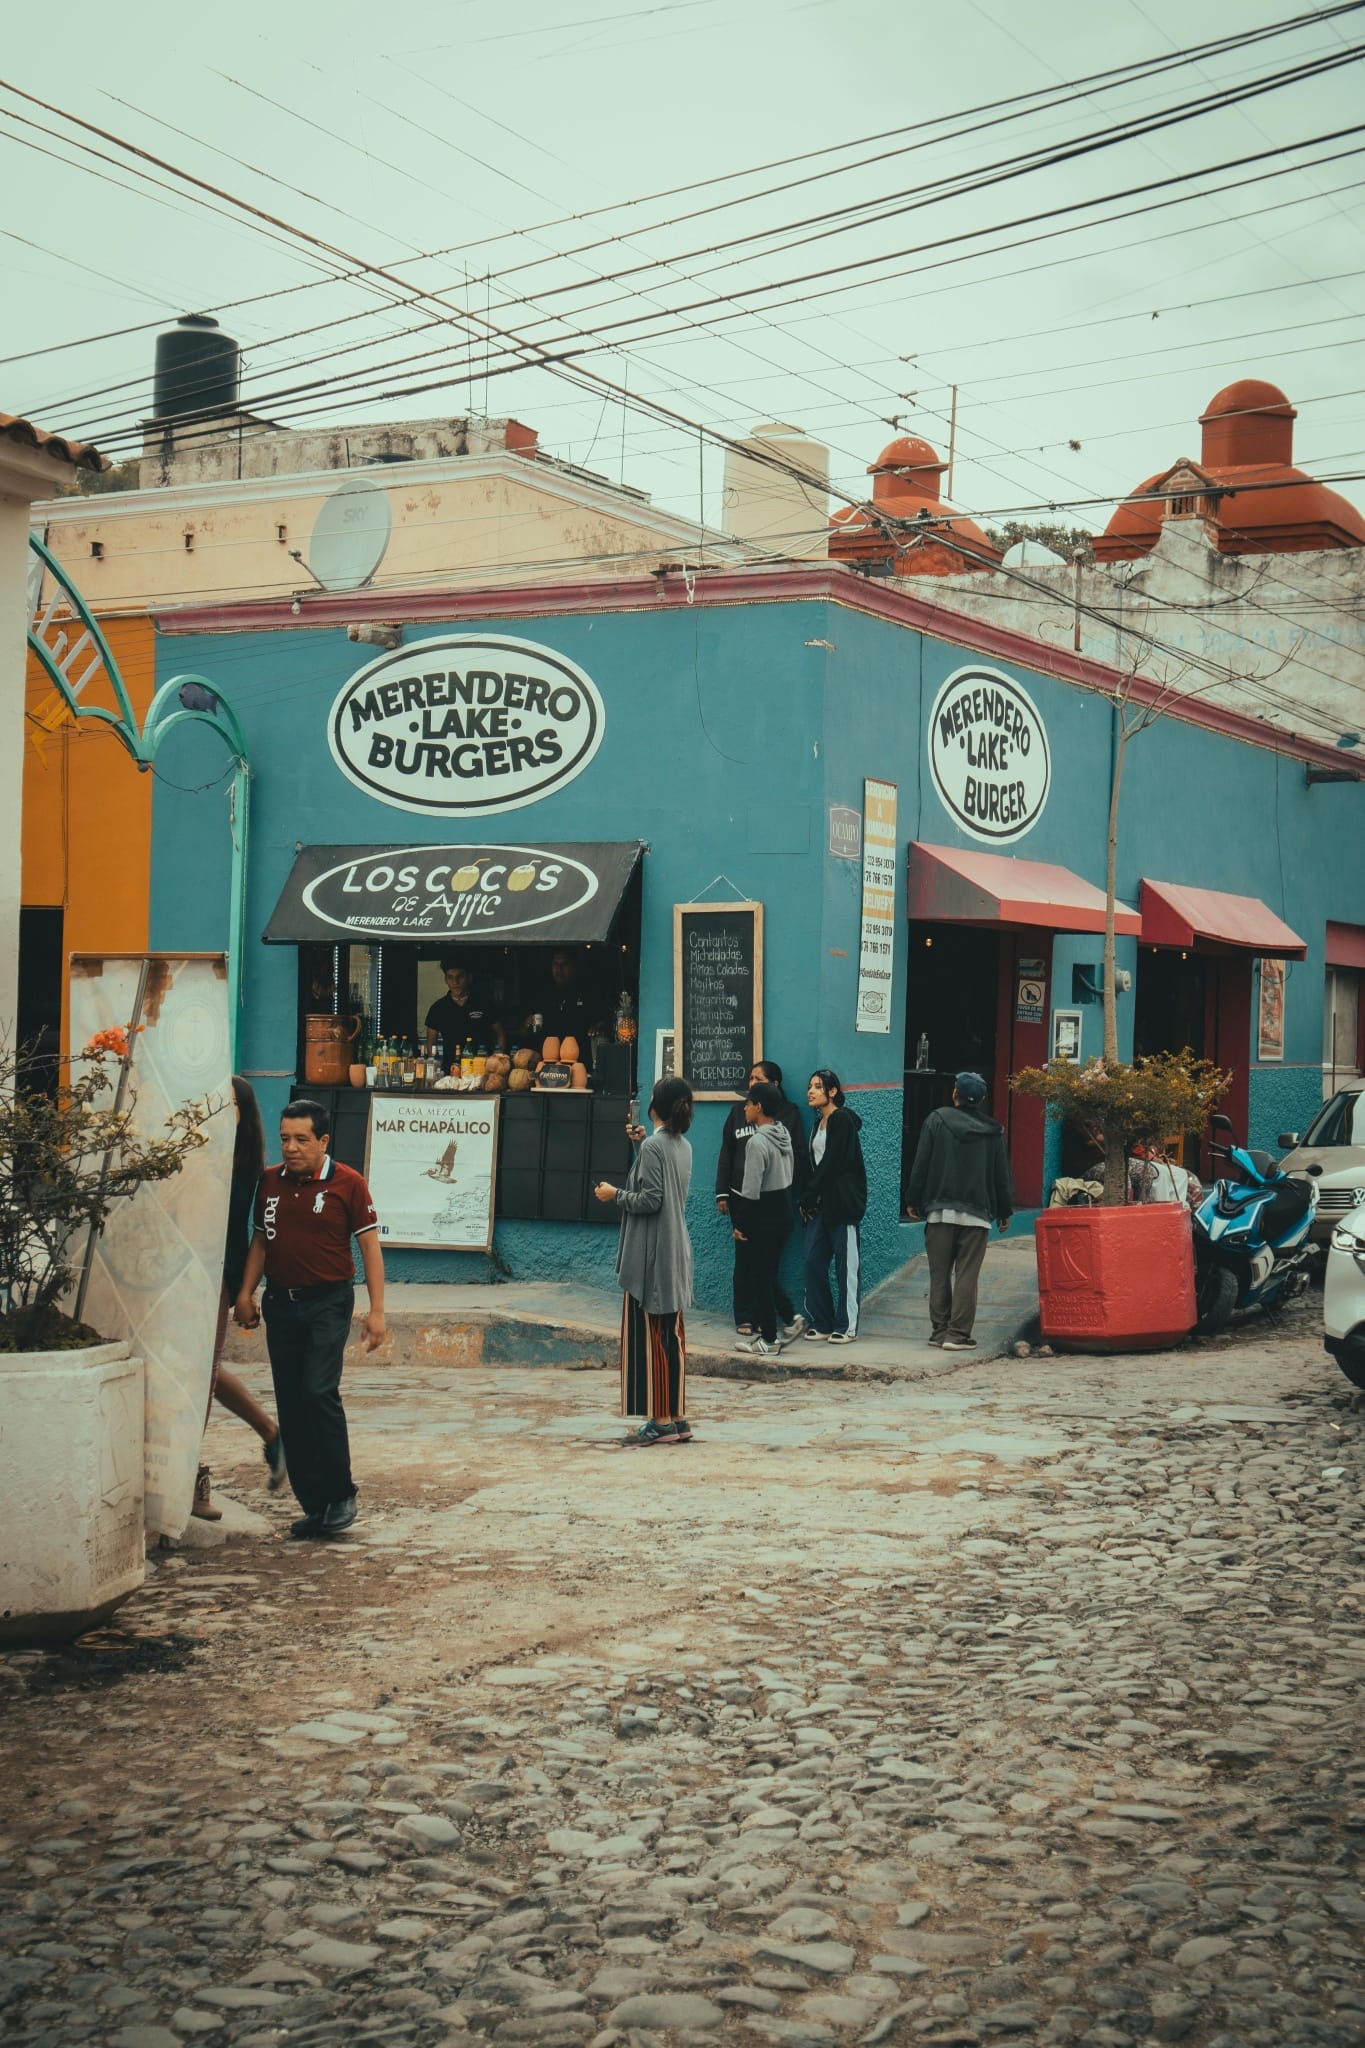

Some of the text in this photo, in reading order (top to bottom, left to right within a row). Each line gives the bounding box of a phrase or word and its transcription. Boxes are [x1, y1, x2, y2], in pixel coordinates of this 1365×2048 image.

[342, 506, 369, 523] SKY
[349, 670, 581, 732] MERENDERO
[422, 707, 509, 740] LAKE
[939, 687, 1031, 757] MERENDERO
[368, 728, 563, 779] BURGERS
[967, 730, 1009, 771] LAKE
[963, 775, 1027, 824] BURGER
[342, 863, 564, 893] LOS COCOS
[345, 915, 433, 927] MERENDERO LAKE
[692, 1066, 746, 1080] MERENDERO
[376, 1118, 491, 1135] MAR CHAPÁLICO
[398, 1107, 467, 1117] CASA MEZCAL
[263, 1195, 280, 1240] POLO
